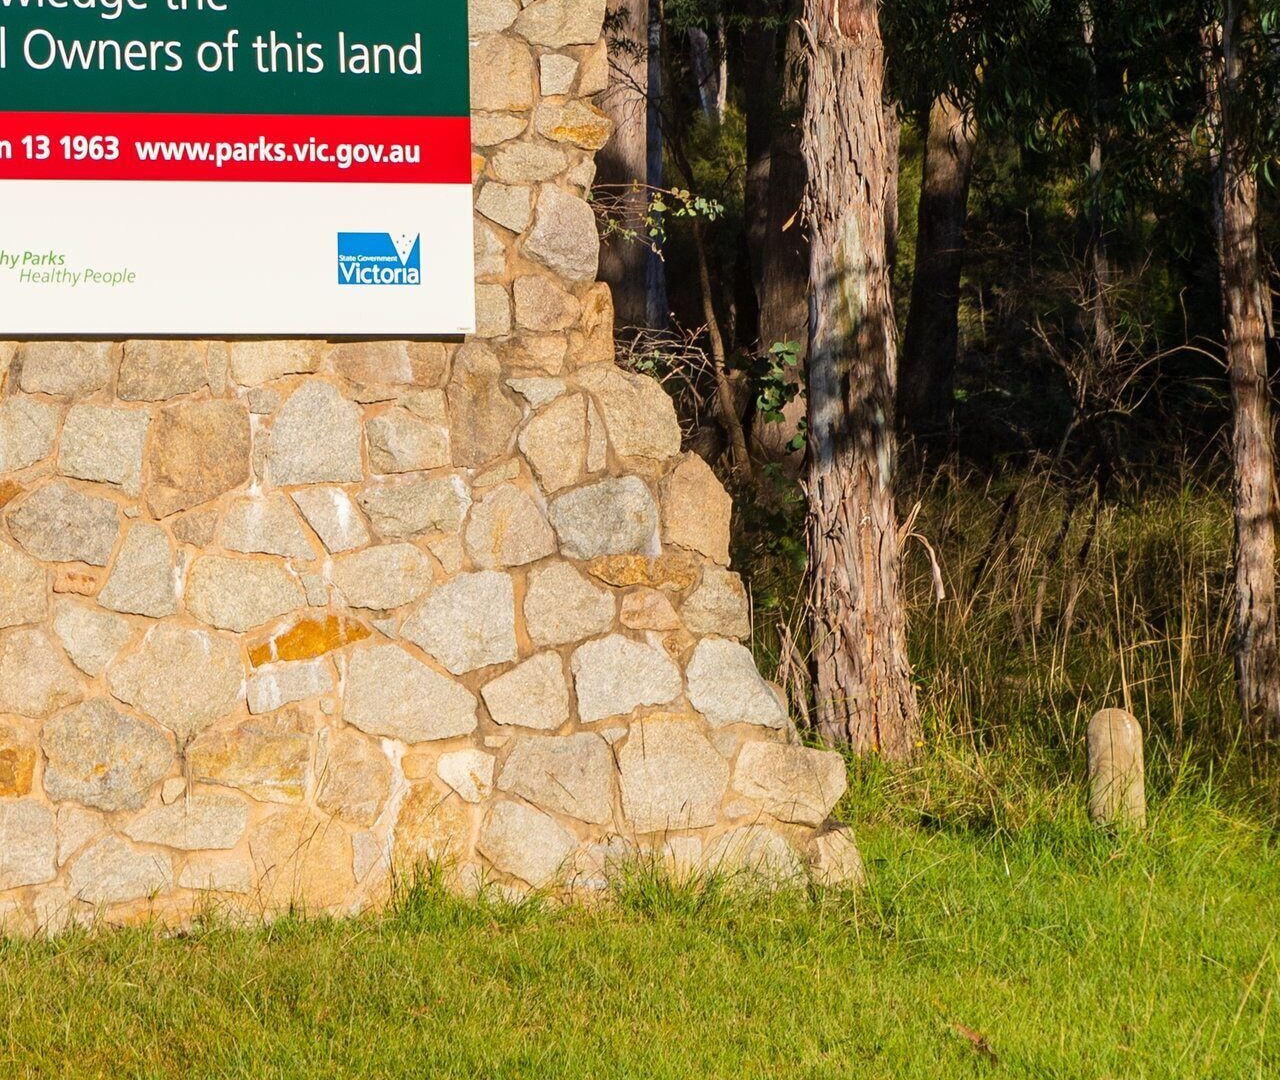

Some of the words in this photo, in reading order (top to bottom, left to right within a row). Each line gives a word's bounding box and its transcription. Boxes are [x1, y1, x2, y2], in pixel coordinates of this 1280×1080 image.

[23, 28, 183, 72] Owners
[196, 29, 239, 72] of
[251, 30, 324, 74] this
[338, 31, 422, 75] land
[21, 134, 51, 160] 13
[59, 135, 120, 161] 1963
[134, 135, 420, 169] www.parks.vic.gov.au
[22, 249, 66, 266] Parks
[19, 267, 82, 288] Healthy
[84, 267, 137, 288] People
[339, 262, 420, 284] Victoria
